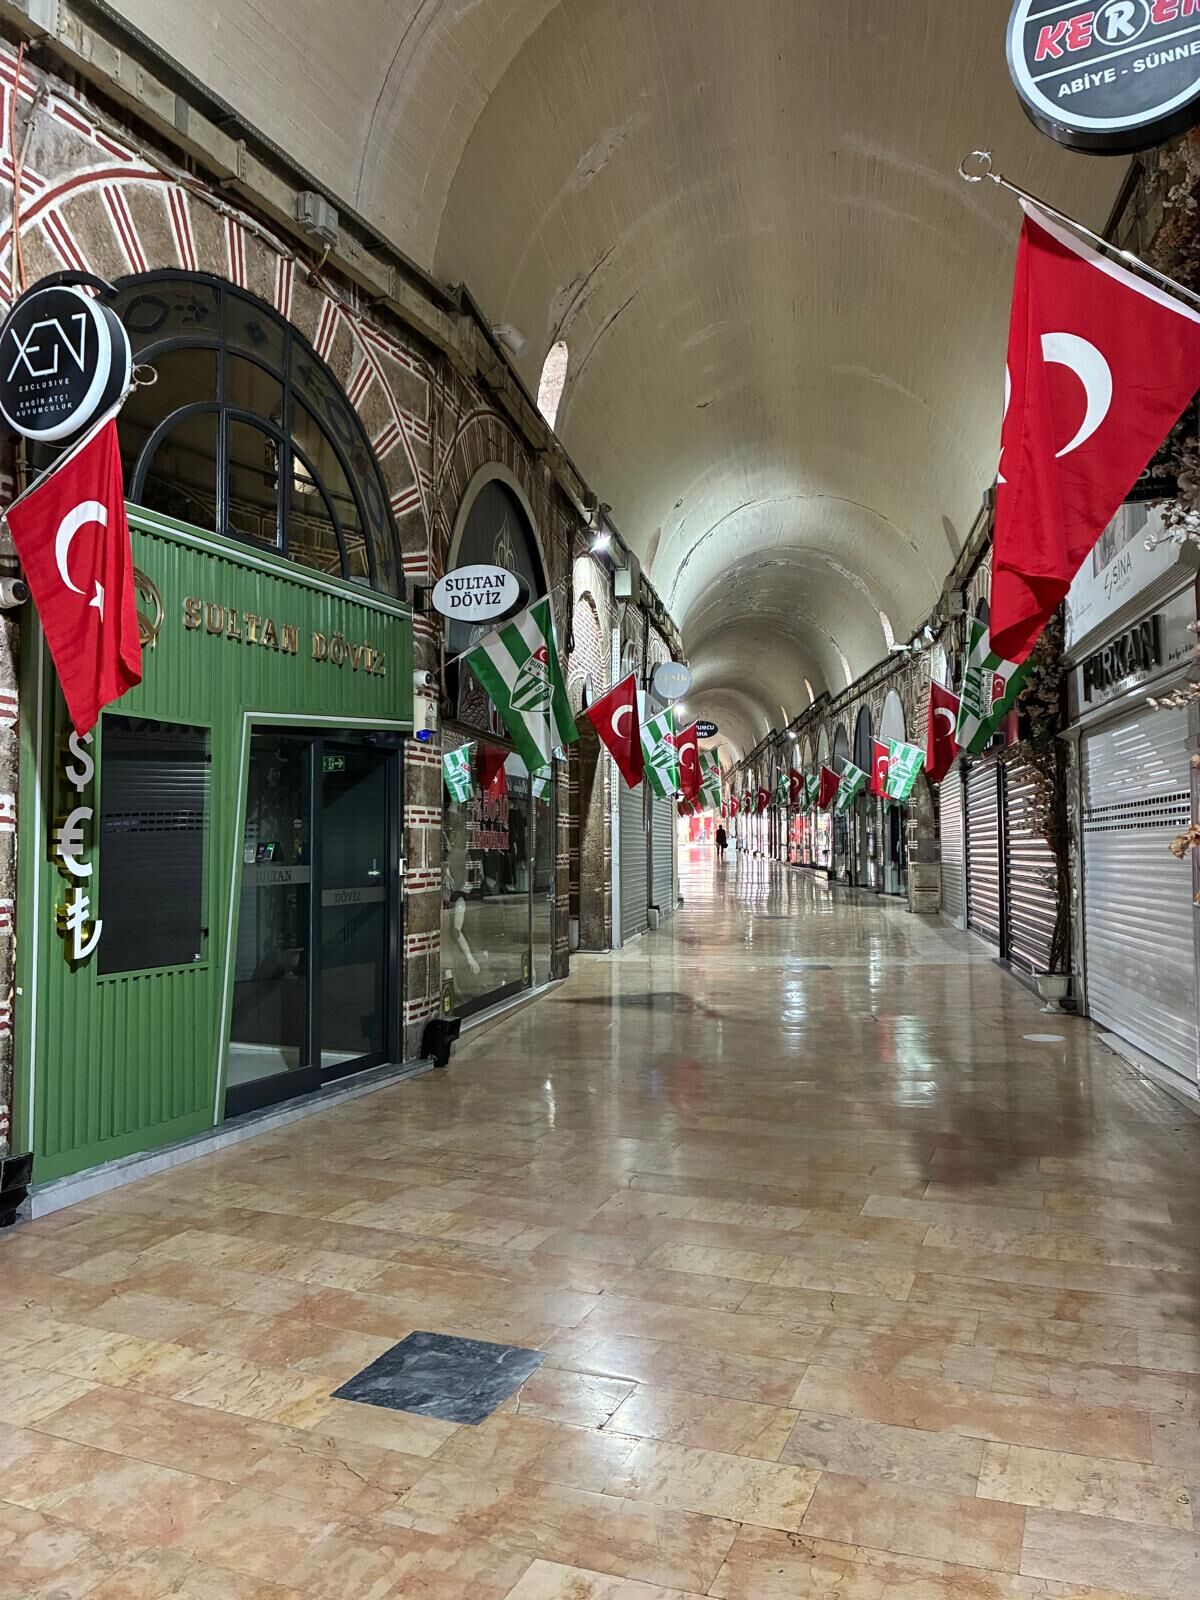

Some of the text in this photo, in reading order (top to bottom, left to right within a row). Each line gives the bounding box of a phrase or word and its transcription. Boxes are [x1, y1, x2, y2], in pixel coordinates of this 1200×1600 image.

[1057, 68, 1117, 98] ABİYE
[18, 377, 70, 393] EXCLUSIVE
[16, 402, 73, 417] KUYUMCULUK
[445, 574, 507, 592] SULTAN
[450, 589, 501, 608] DÖVİZ
[183, 596, 300, 656] SULTAN
[311, 630, 386, 678] DÖVİZ
[334, 889, 362, 904] DÖVİZ
